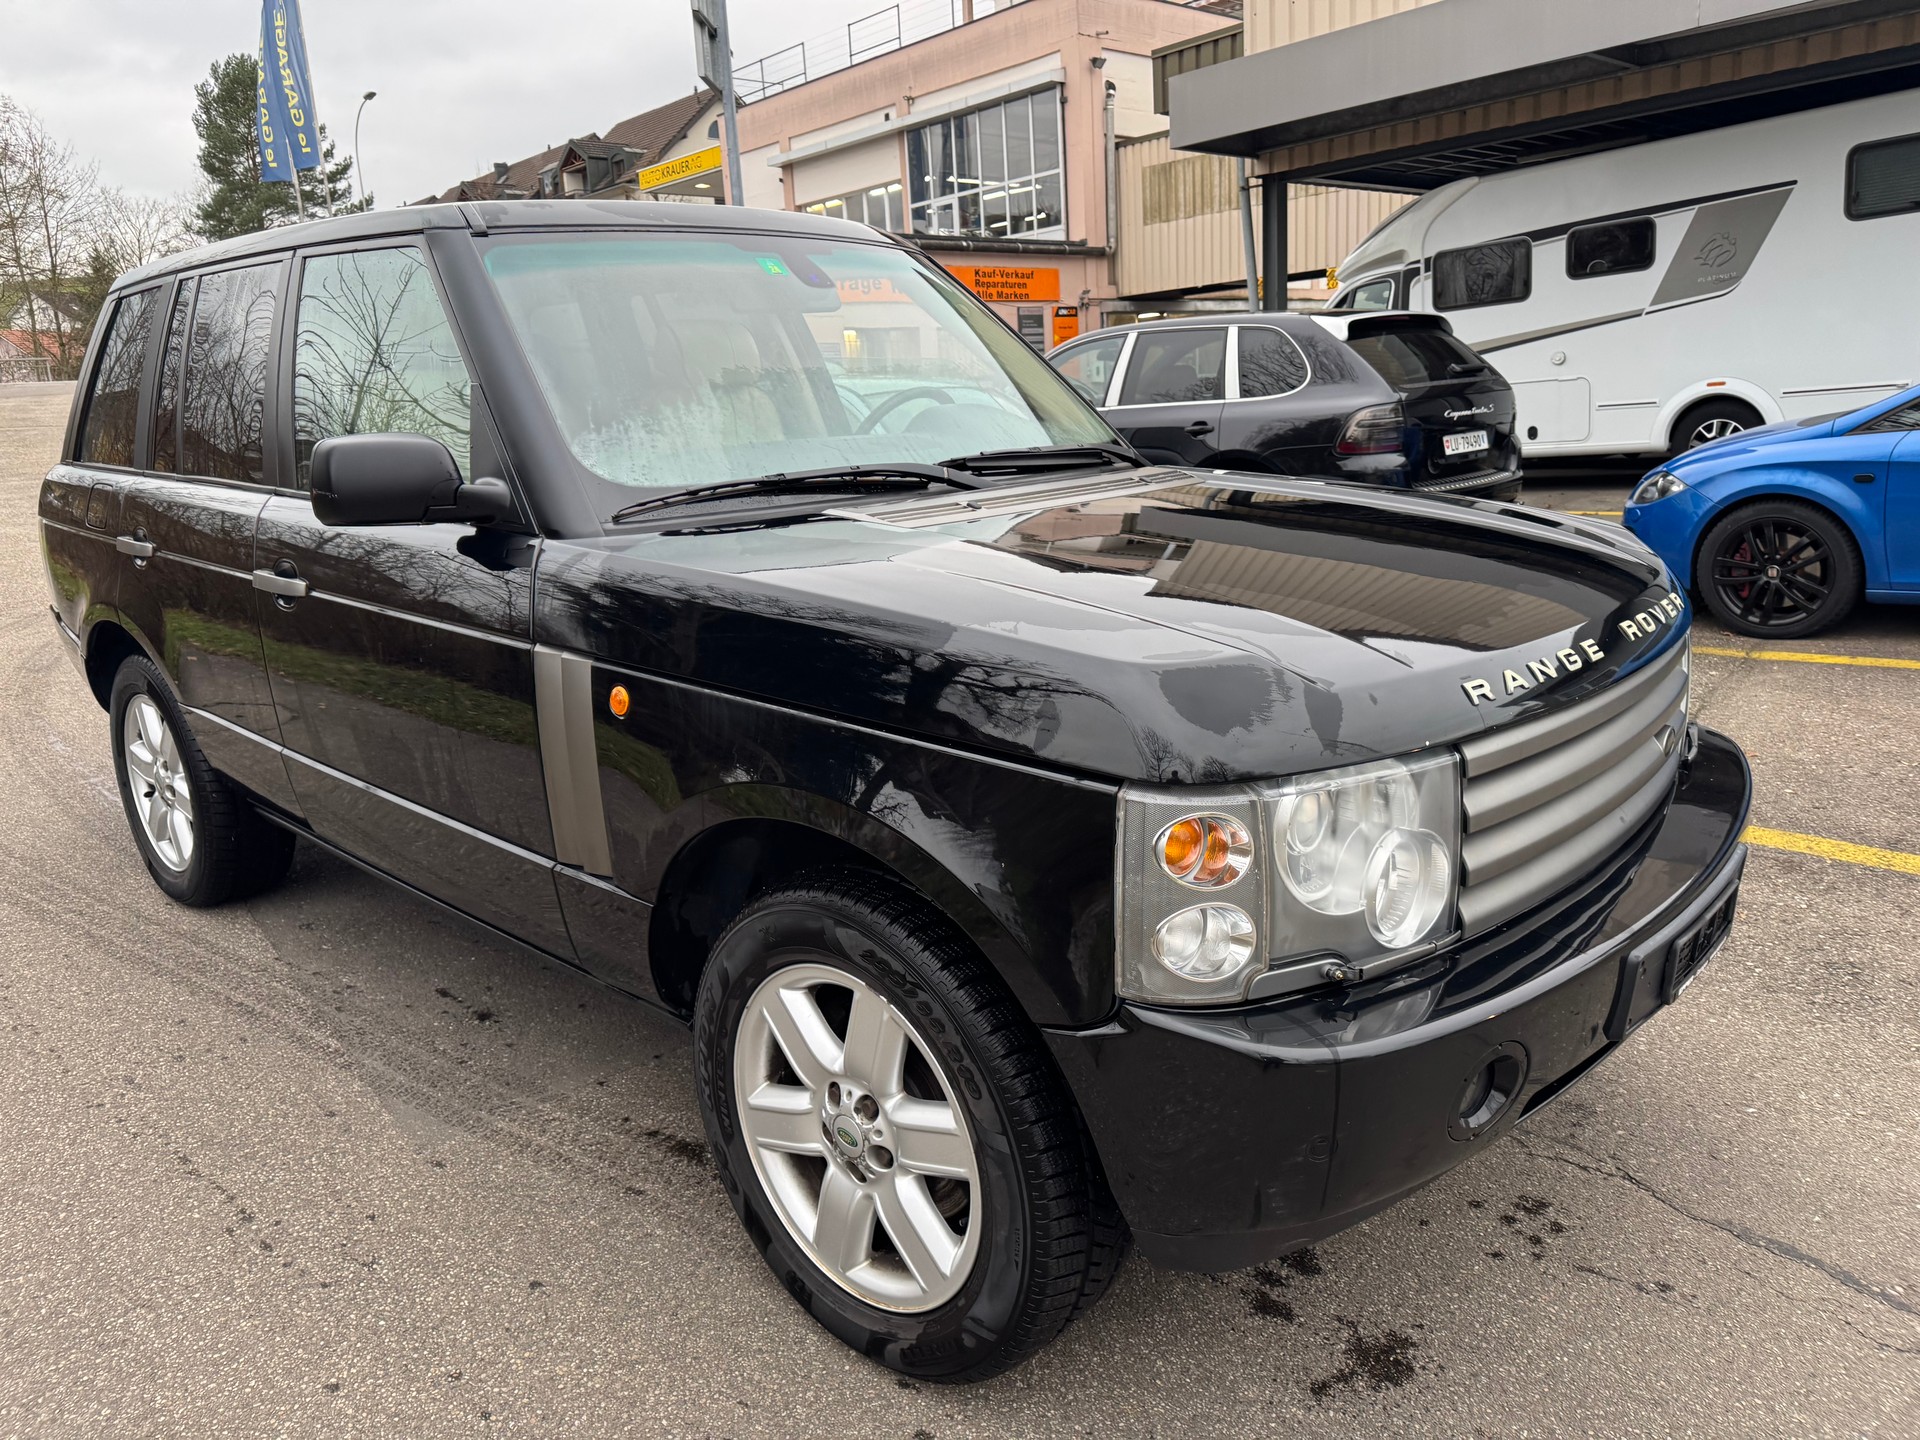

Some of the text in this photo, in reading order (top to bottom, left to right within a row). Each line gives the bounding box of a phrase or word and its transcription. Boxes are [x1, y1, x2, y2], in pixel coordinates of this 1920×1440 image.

[974, 268, 1035, 279] Kauf-Verkauf
[974, 279, 1028, 289] Reparaturen
[996, 291, 1030, 300] Marken
[1461, 592, 1685, 706] RANGE ROVER
